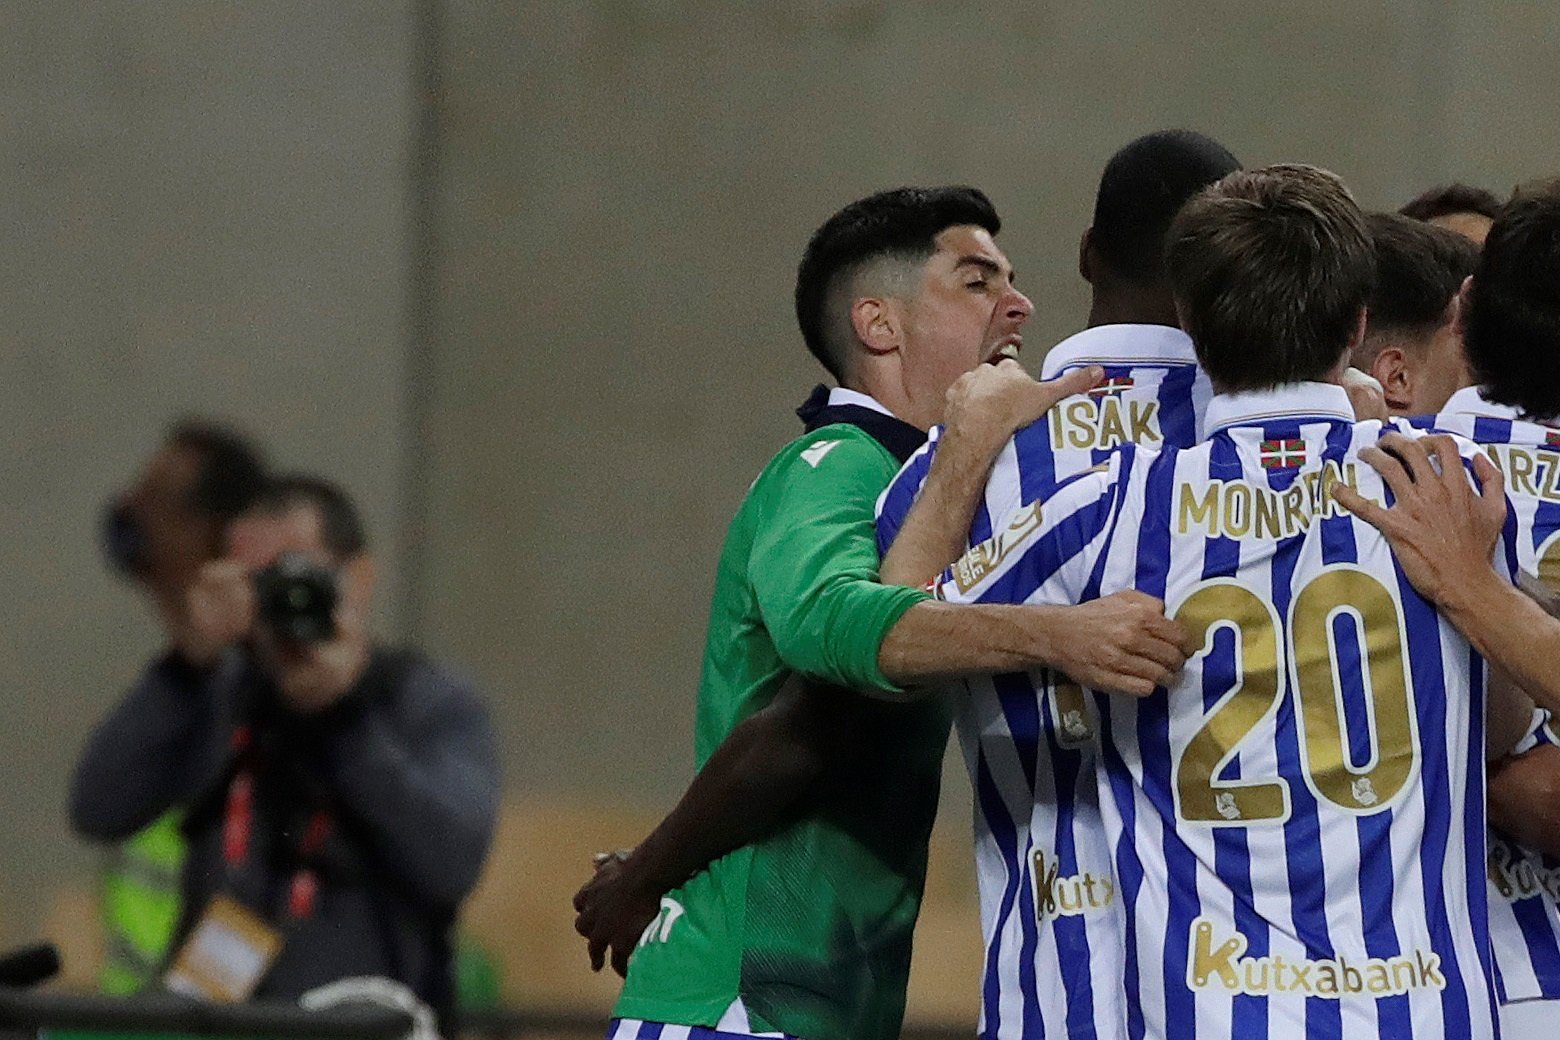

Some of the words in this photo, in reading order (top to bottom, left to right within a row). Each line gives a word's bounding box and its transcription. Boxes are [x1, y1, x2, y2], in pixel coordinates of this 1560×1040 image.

[1052, 400, 1160, 449] ISAK
[1177, 567, 1418, 822] 20
[1194, 920, 1443, 994] Kutxabank
